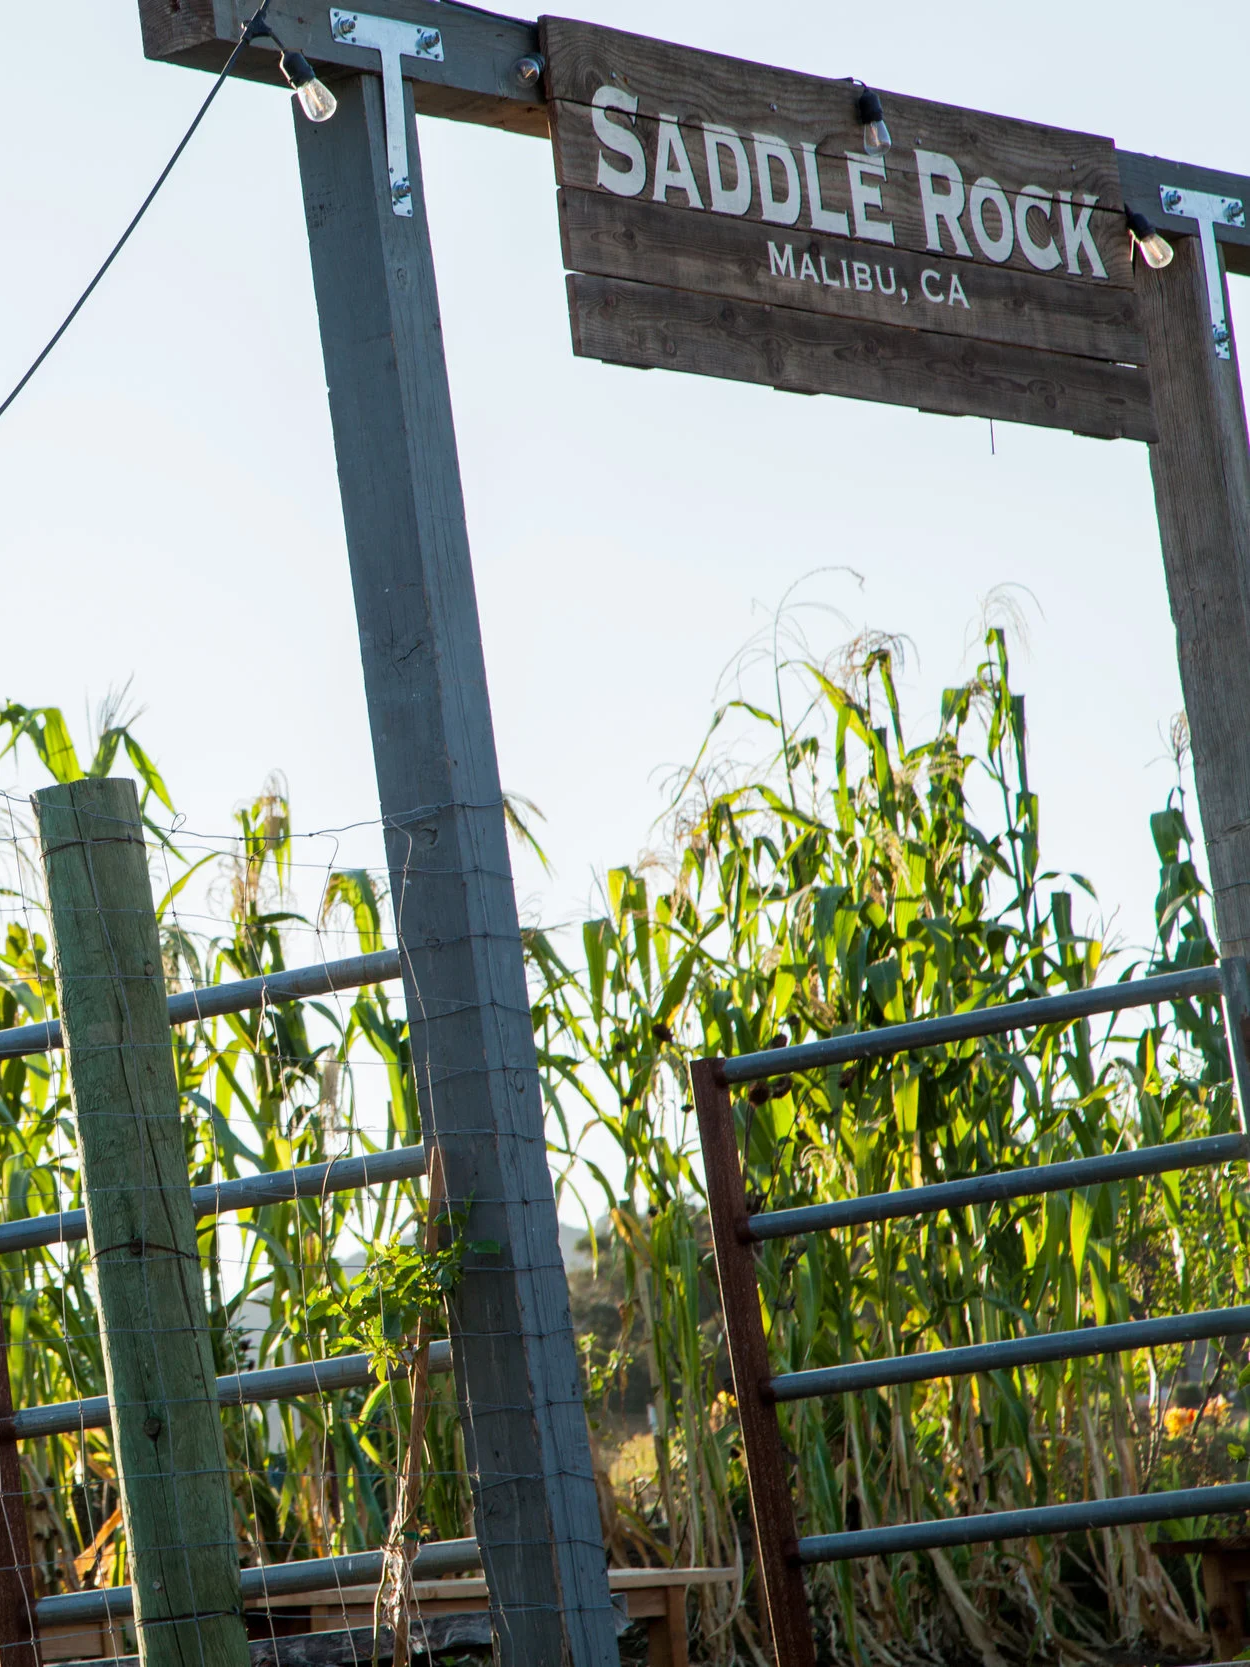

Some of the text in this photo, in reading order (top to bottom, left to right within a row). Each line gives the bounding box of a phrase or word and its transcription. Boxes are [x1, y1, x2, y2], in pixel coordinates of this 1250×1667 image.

[591, 85, 1109, 279] SADDLE ROCK
[767, 241, 971, 309] MALIBU, CA
